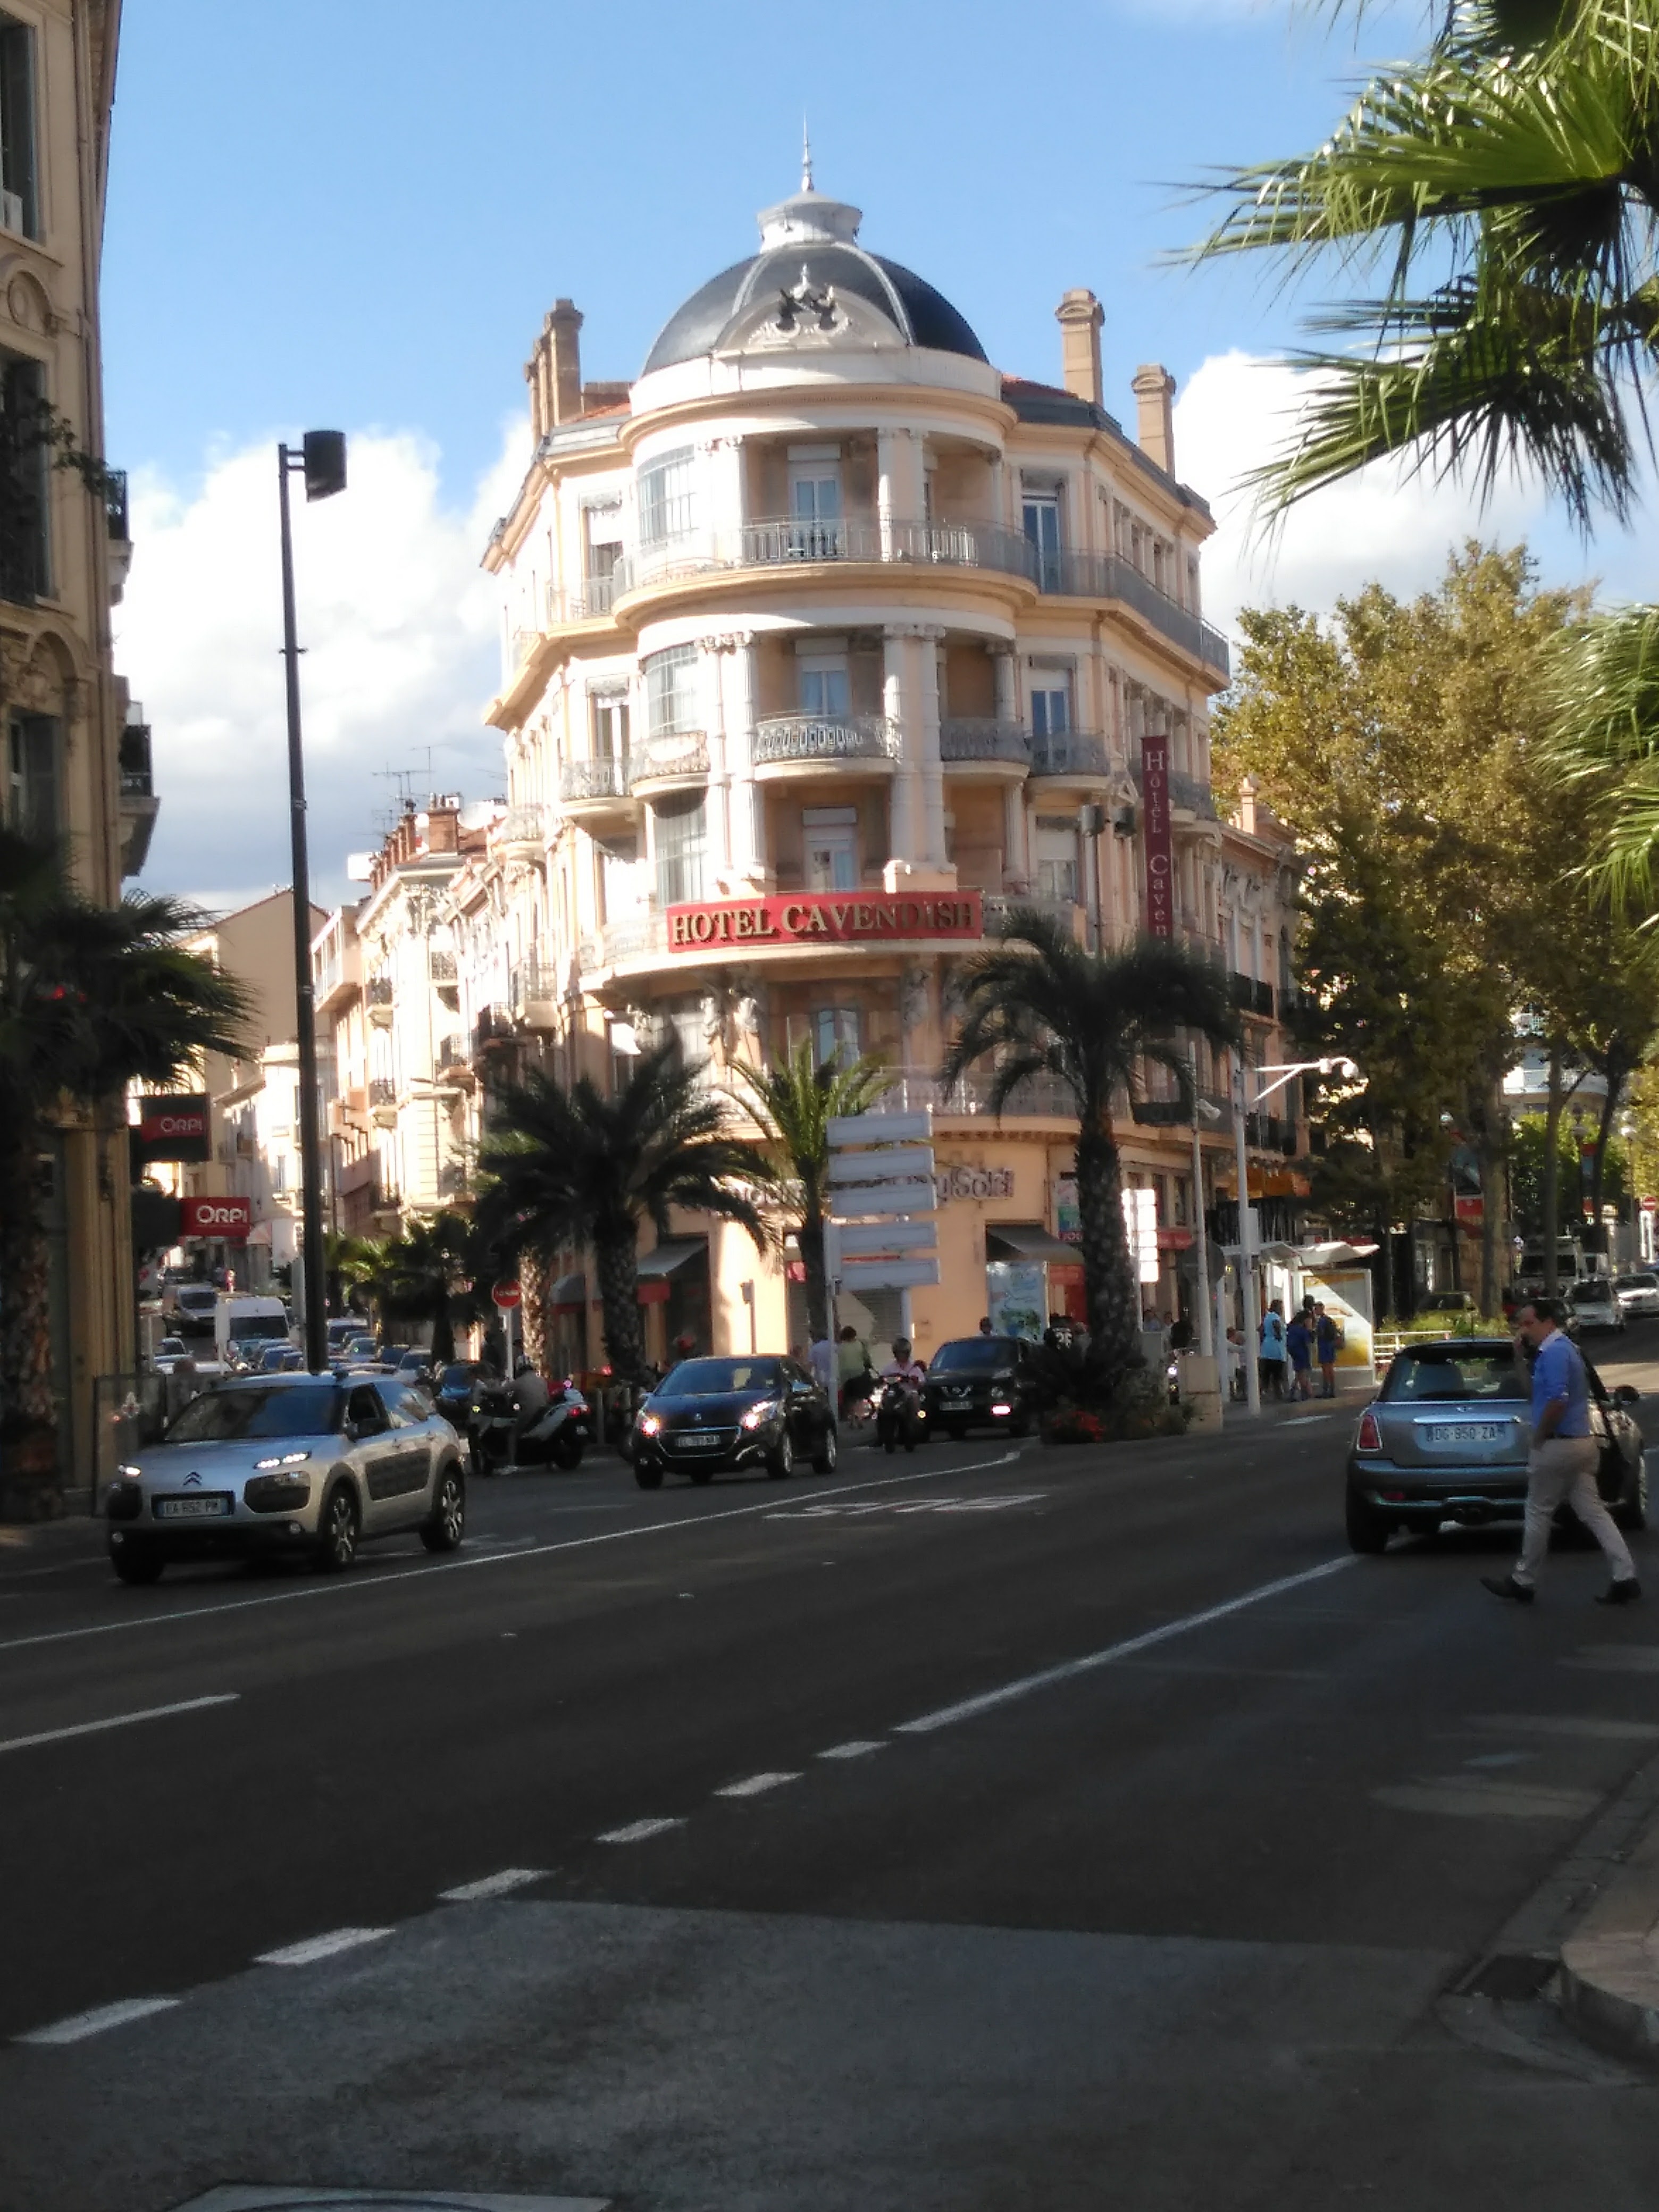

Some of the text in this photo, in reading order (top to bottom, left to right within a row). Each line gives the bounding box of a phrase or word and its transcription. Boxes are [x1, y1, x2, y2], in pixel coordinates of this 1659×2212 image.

[1151, 854, 1167, 936] Caven
[671, 901, 975, 945] HOTEL CAVENDISH
[196, 1205, 247, 1223] ORPI
